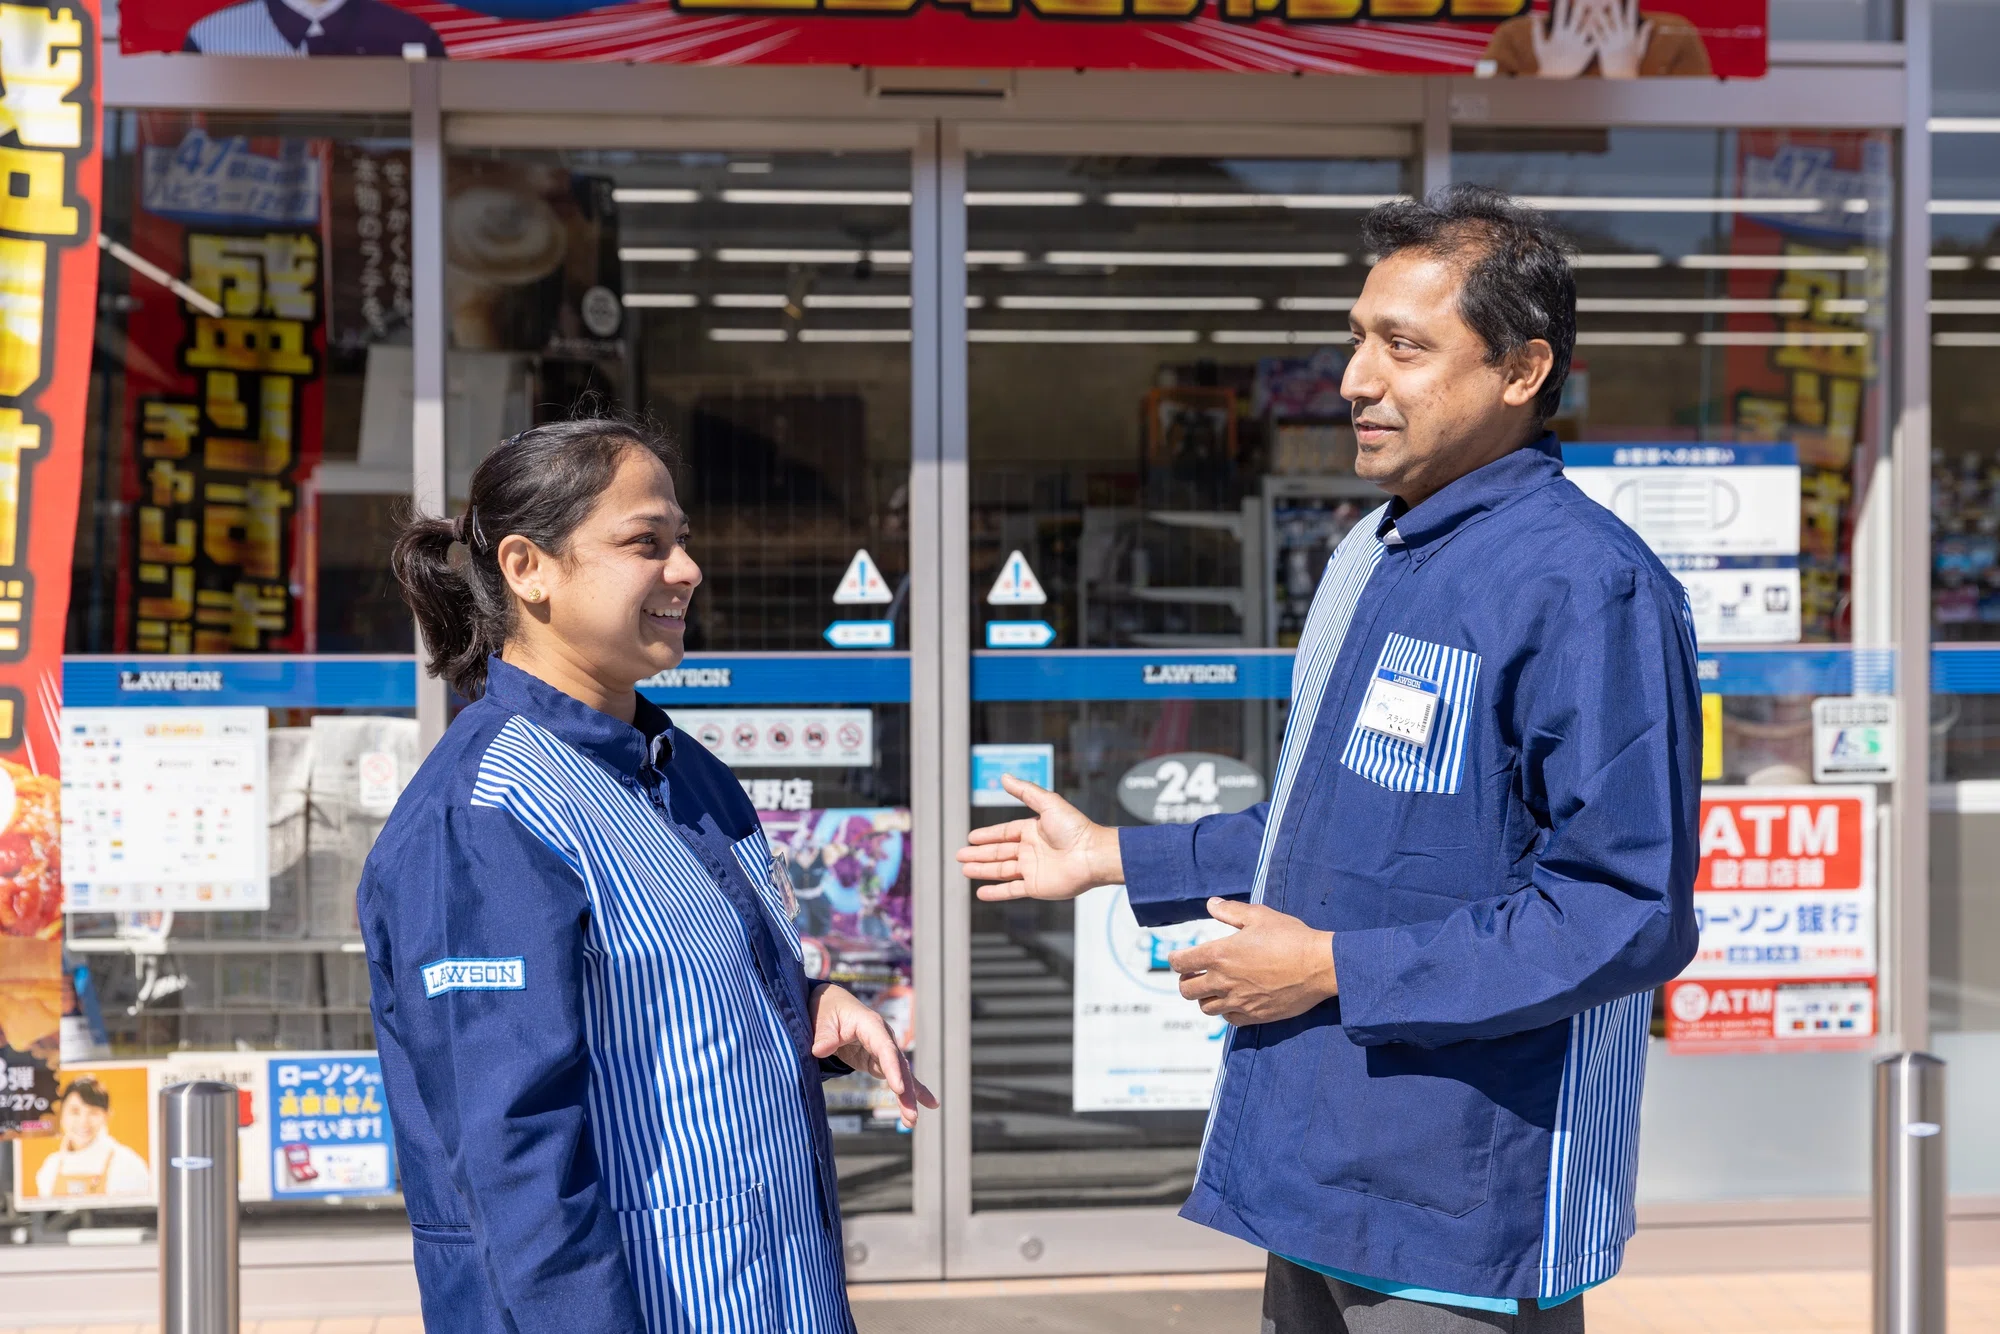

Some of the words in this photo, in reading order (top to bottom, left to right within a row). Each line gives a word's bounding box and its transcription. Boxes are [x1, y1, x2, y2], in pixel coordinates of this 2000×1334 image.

[1613, 447, 1735, 466] お客様へのお願い
[120, 670, 223, 691] LAWSON
[1143, 664, 1237, 685] LAWSON
[1393, 674, 1421, 689] LAWSON
[1386, 714, 1421, 728] スランジット
[1156, 761, 1219, 804] 24
[1701, 805, 1839, 857] ATM
[1711, 858, 1825, 888] 設置店舗
[429, 965, 517, 989] LAWSON
[1709, 988, 1773, 1015] ATM
[280, 1117, 382, 1142] 出ています!
